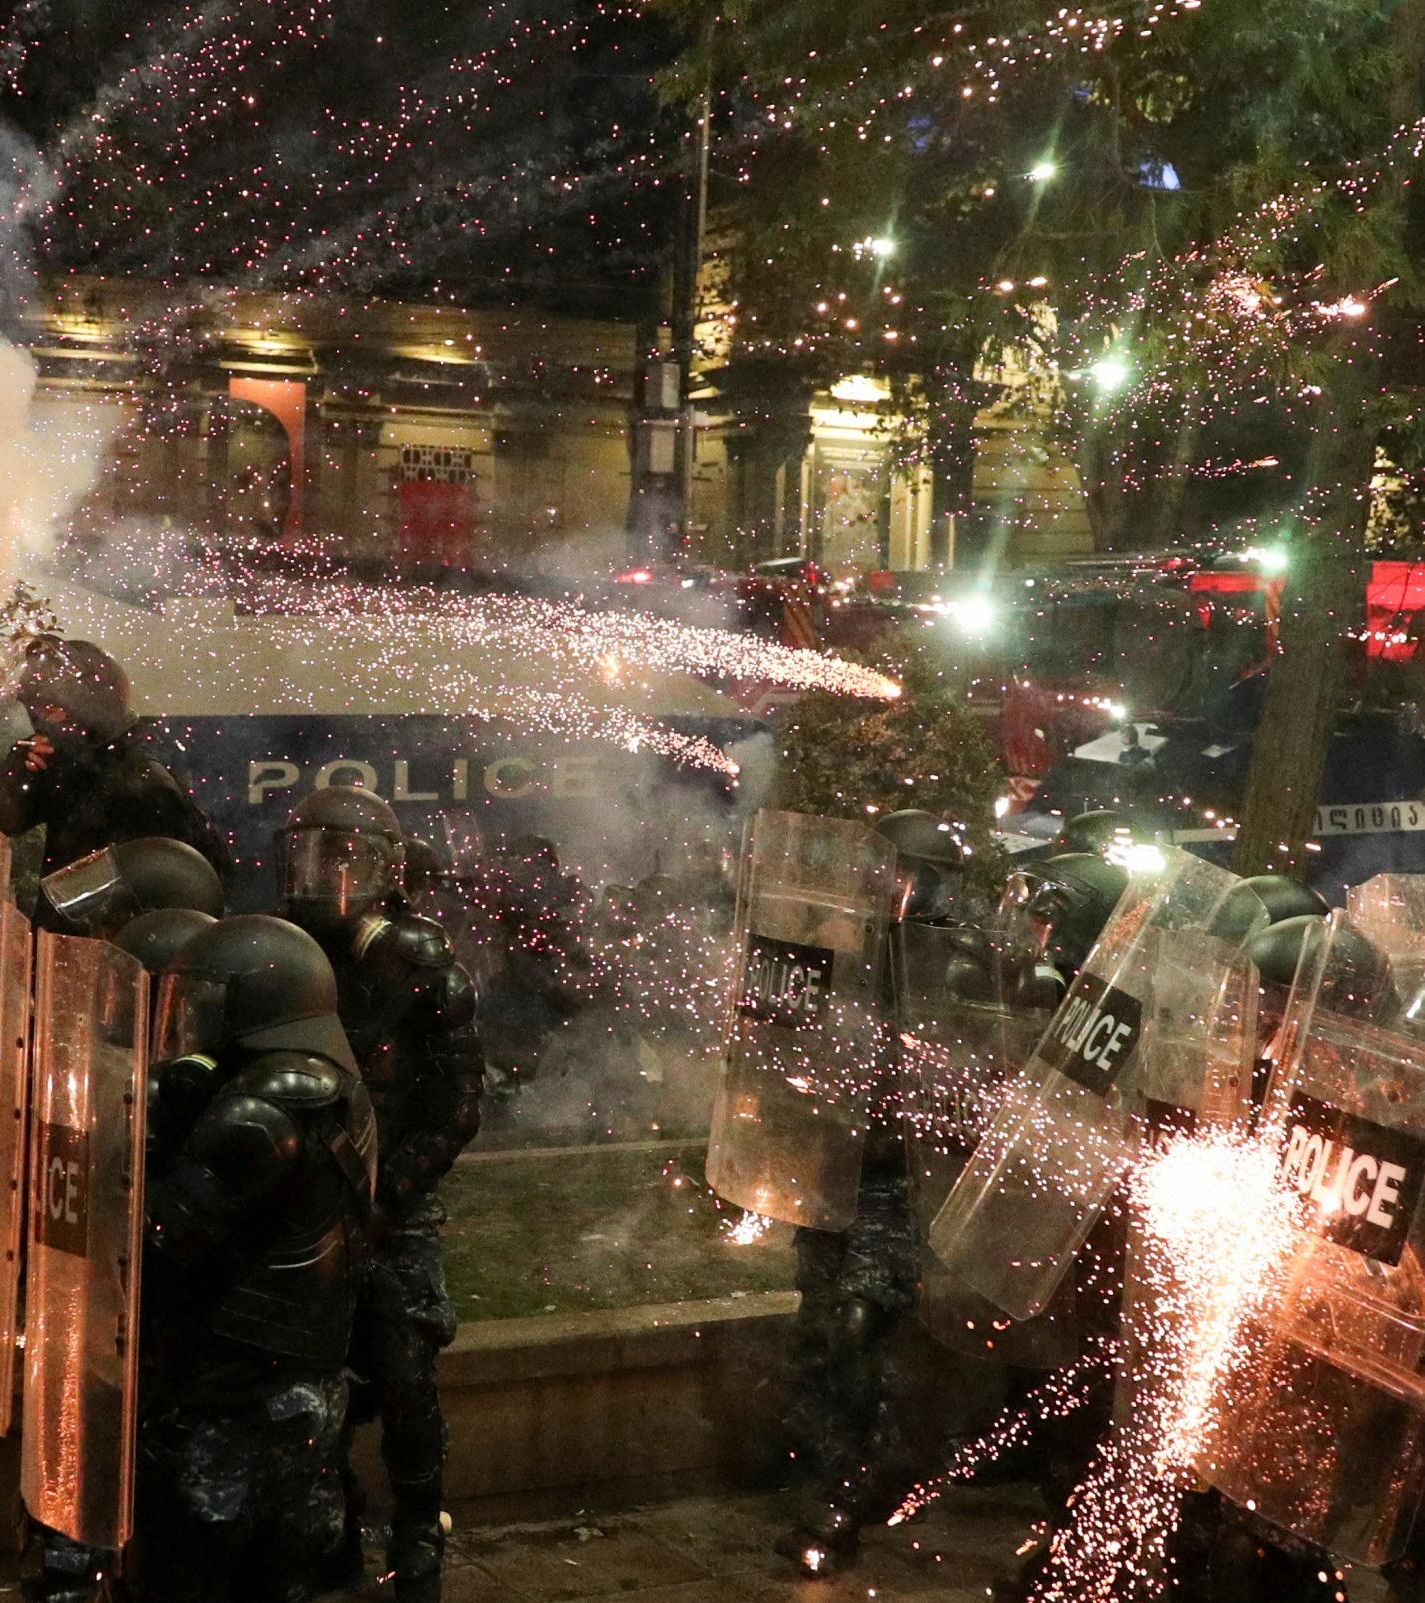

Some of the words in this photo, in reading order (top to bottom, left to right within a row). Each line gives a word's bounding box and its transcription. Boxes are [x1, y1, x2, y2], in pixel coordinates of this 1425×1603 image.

[248, 757, 601, 804] POLICE
[1054, 996, 1132, 1071] POLICE
[1281, 1124, 1406, 1229] POLICE
